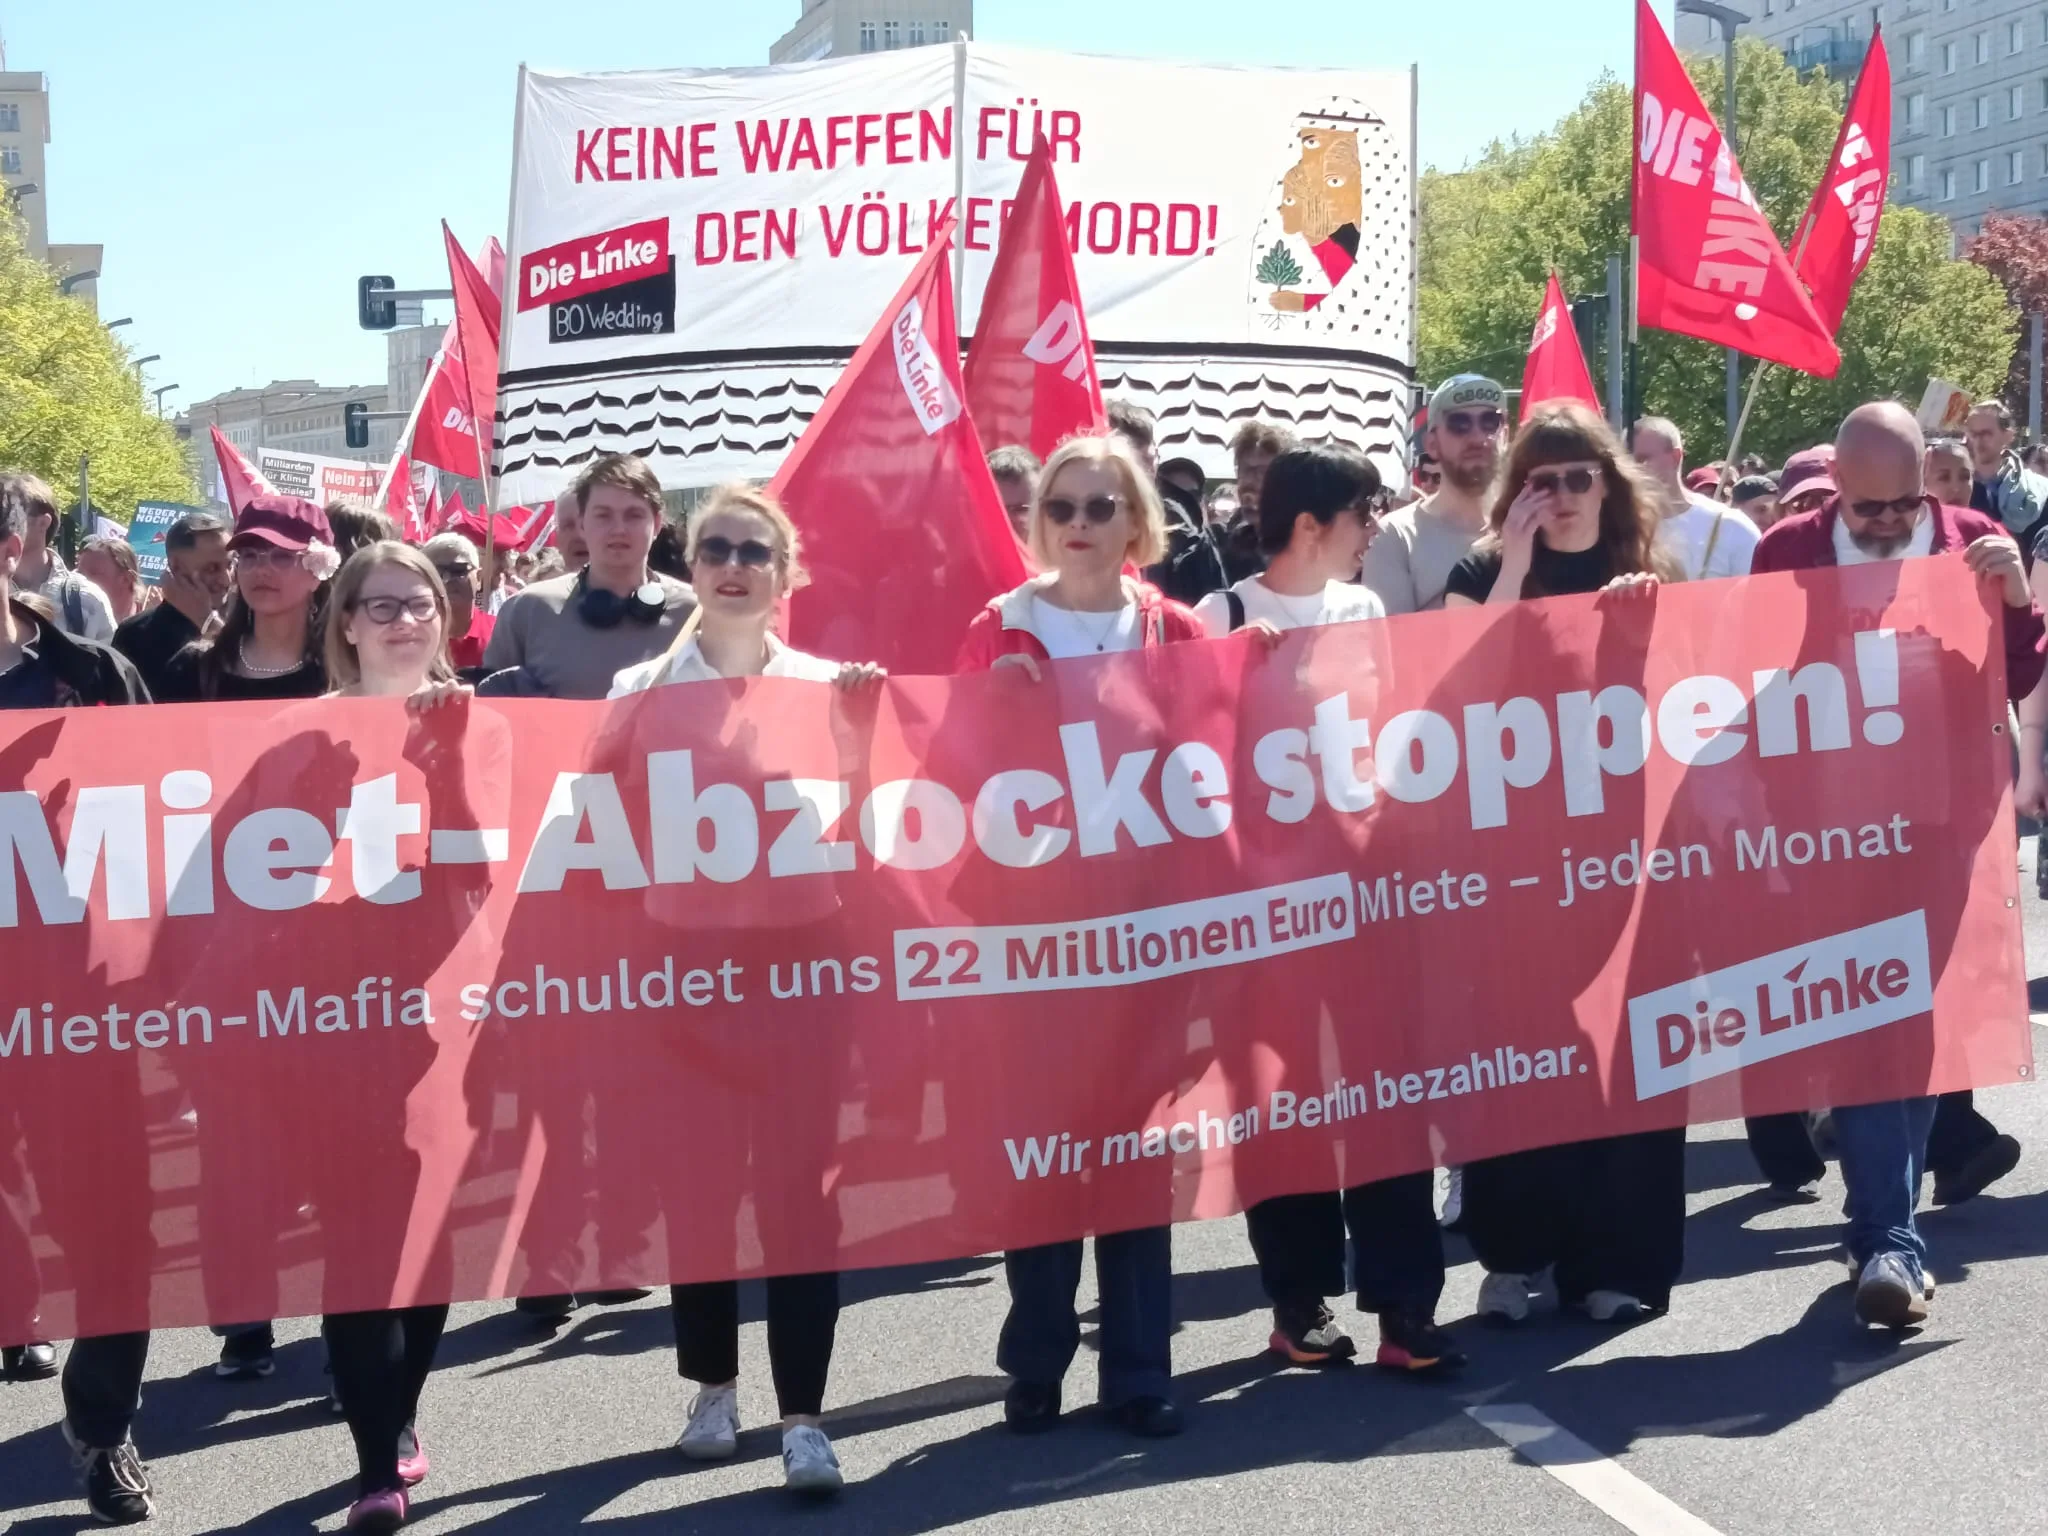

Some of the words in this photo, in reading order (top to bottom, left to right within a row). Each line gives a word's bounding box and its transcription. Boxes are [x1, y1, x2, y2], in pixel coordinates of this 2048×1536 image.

[575, 122, 718, 184] KEINE
[735, 105, 954, 174] WAFFEN
[976, 97, 1082, 164] FÜR
[1639, 91, 1714, 187] DIE
[529, 257, 576, 299] Die
[579, 236, 659, 281] Linke
[695, 207, 797, 267] DEN
[555, 303, 585, 337] BO
[585, 301, 664, 335] Wedding
[897, 311, 917, 356] Die
[1022, 299, 1091, 394] DI
[905, 351, 944, 421] Linke
[264, 458, 313, 473] Milliarden
[272, 484, 313, 497] oziales!
[280, 473, 307, 484] Klima
[325, 469, 356, 487] Nein
[358, 475, 374, 488] zu
[136, 513, 170, 525] NOCH
[138, 506, 176, 518] WEDER
[0, 720, 1233, 929] Miet-Abzocke
[1252, 627, 1905, 831] stoppen!
[0, 976, 435, 1059] Mieten-Mafia
[459, 955, 745, 1022] schuldet
[769, 954, 881, 999] uns
[904, 938, 982, 989] 22
[1005, 914, 1258, 983] Millionen
[1267, 896, 1348, 945] Euro
[1357, 868, 1489, 926] Miete
[1558, 838, 1712, 907] jeden
[1734, 812, 1914, 873] Monat
[1655, 1000, 1747, 1070] Die
[1756, 956, 1911, 1037] Linke
[1003, 1130, 1092, 1181] Wir
[1101, 1104, 1260, 1167] machen
[1268, 1077, 1367, 1131] Berlin
[1373, 1045, 1589, 1110] bezahlbar.
